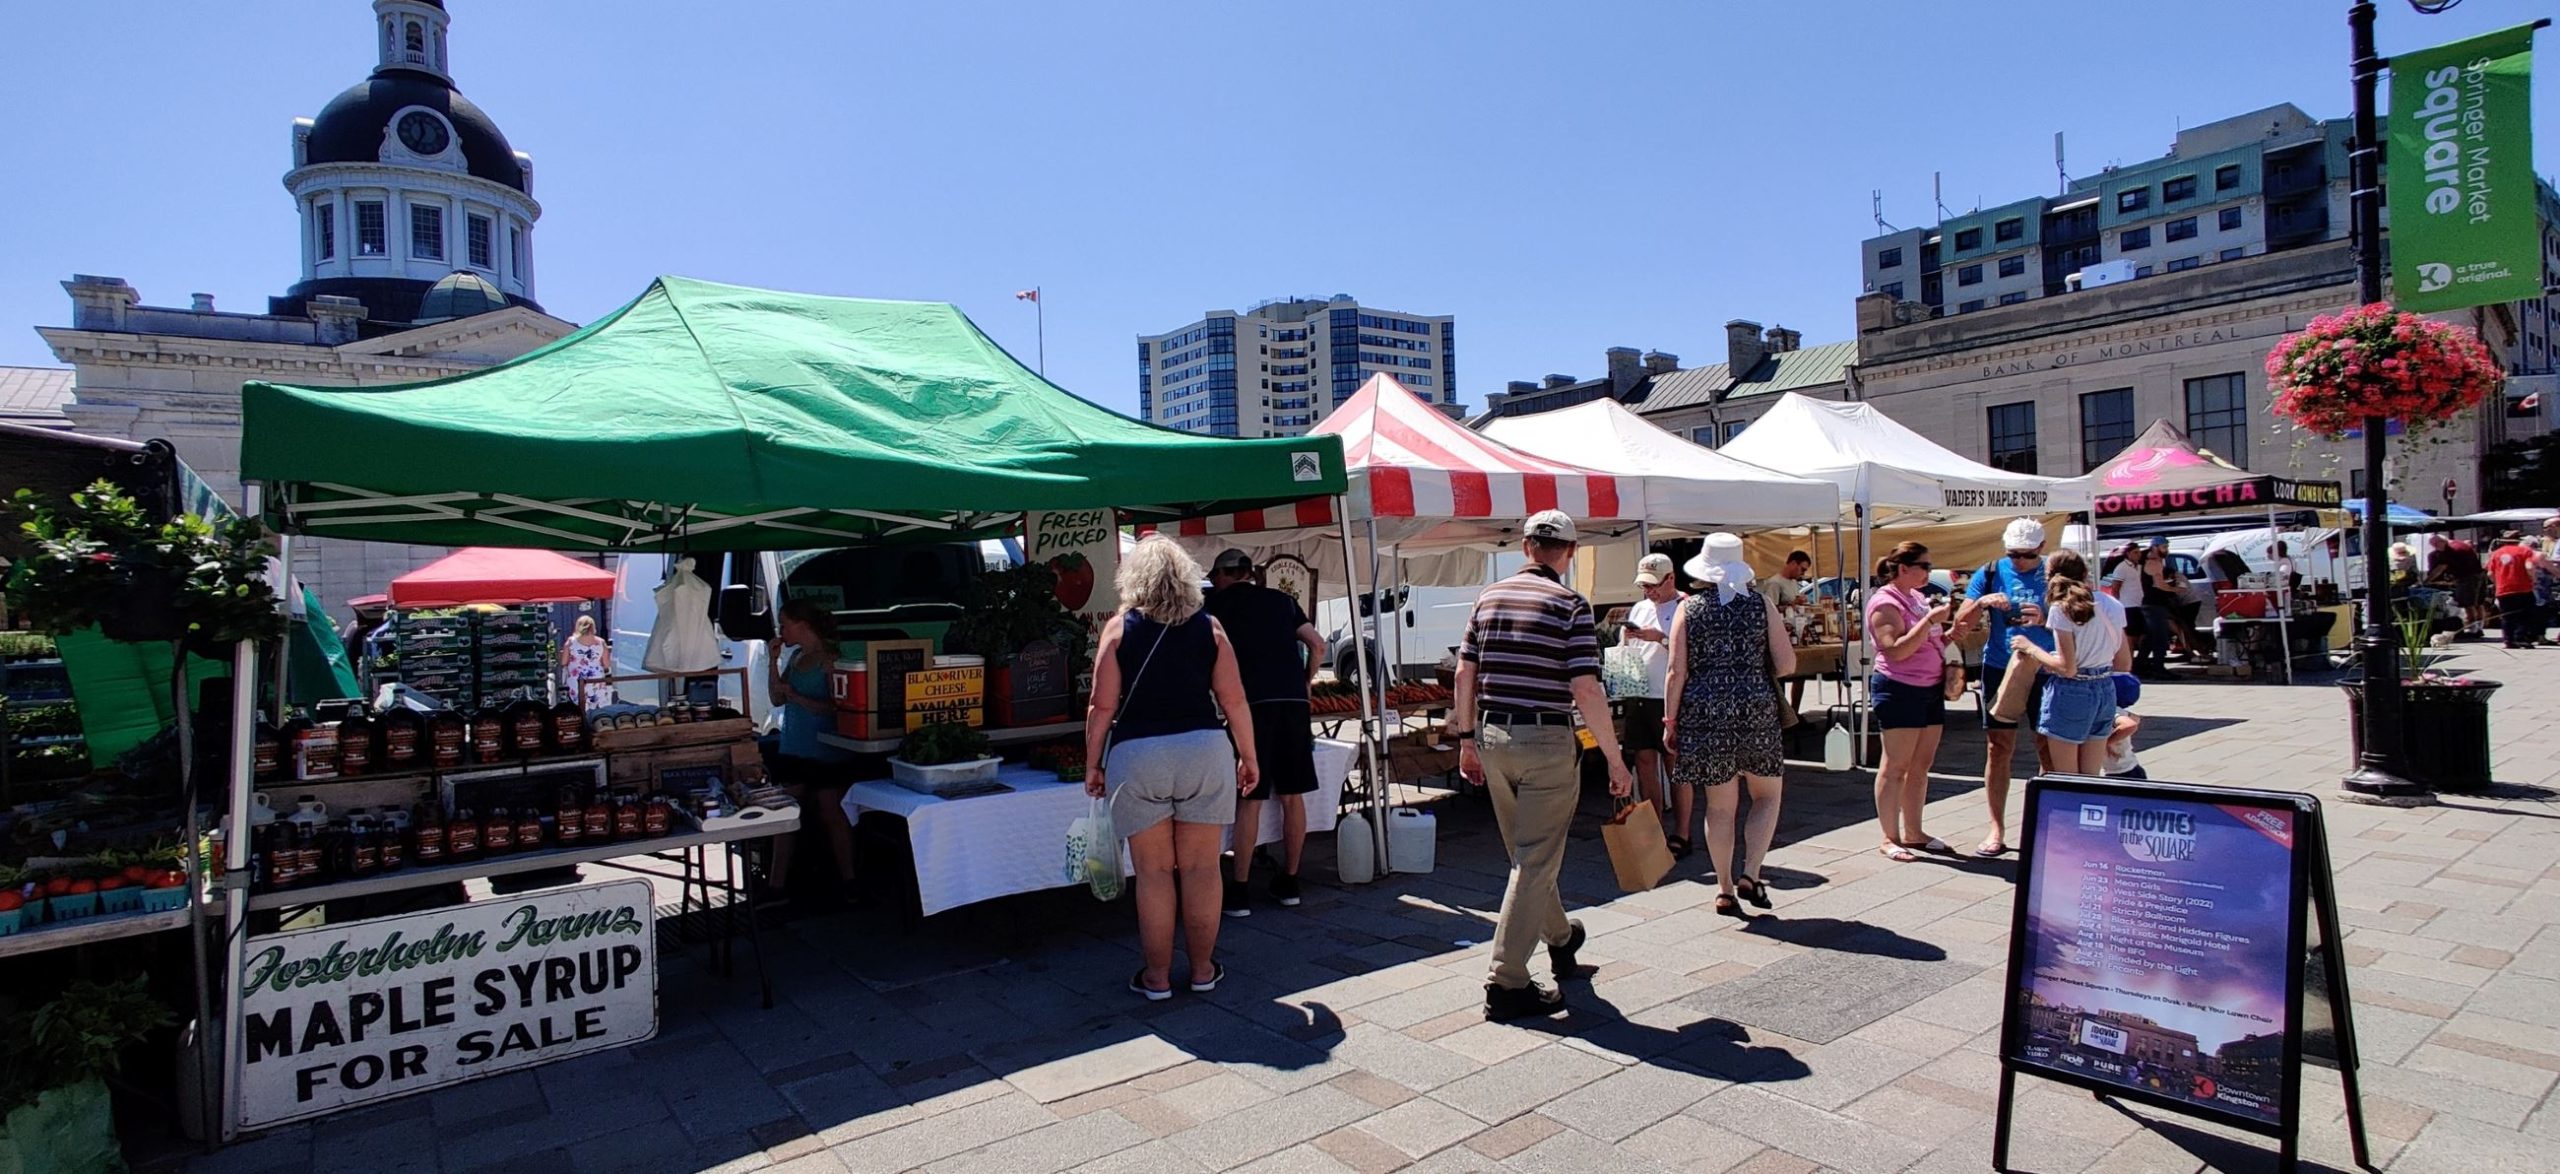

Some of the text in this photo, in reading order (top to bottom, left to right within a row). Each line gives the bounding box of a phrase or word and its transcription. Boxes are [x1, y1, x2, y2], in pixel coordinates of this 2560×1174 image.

[2413, 65, 2460, 214] square
[2461, 57, 2493, 225] Springer Market
[2456, 261, 2497, 273] a true
[2457, 268, 2512, 285] original.
[1983, 327, 2241, 378] BANK OF MONTREAL
[1945, 489, 2048, 507] VADER'S MAPLE SYRUP
[1039, 511, 1103, 532] FRESH
[1036, 528, 1107, 555] PICKED
[907, 668, 983, 685] BLACK RIVER
[924, 682, 967, 697] CHEESE
[911, 697, 980, 711] AVAILABLE
[922, 709, 970, 725] HERE
[2084, 808, 2104, 821] TD
[2120, 808, 2196, 836] MOVIES
[2257, 810, 2286, 830] FREE
[2119, 829, 2195, 862] in the SQUARE
[2083, 861, 2098, 869] Jun
[2115, 864, 2166, 877] Rocketman
[2082, 874, 2096, 882] Jun
[2097, 876, 2108, 884] 23
[2114, 879, 2139, 889] Mean
[2140, 881, 2161, 891] Girls
[2112, 897, 2136, 907] Pride
[2137, 900, 2143, 908] &
[2144, 902, 2189, 915] Prejudice
[2113, 888, 2136, 897] West
[2137, 890, 2158, 900] Side
[2158, 892, 2184, 905] Story
[2185, 897, 2214, 909] (2022)
[2112, 906, 2143, 918] Strictly
[2144, 912, 2186, 924] Ballroom
[2110, 924, 2131, 935] Best
[2131, 927, 2160, 940] Exotic
[2161, 932, 2203, 947] Marigold
[2203, 939, 2231, 951] Hotel
[2111, 915, 2136, 926] Black
[2137, 918, 2157, 929] Soul
[2157, 922, 2177, 933] and
[2178, 925, 2214, 939] Hidden
[2215, 931, 2250, 945] Figures
[243, 904, 643, 998] Fosterholm Farms
[2109, 934, 2134, 946] Night
[2135, 938, 2145, 947] at
[2146, 939, 2162, 950] the
[2164, 943, 2205, 957] Museum
[2109, 943, 2126, 953] The
[2127, 946, 2146, 957] BFG
[2107, 963, 2145, 977] Encanto
[2108, 953, 2143, 966] Blinded
[2143, 958, 2155, 970] by
[2157, 960, 2173, 971] the
[2174, 964, 2200, 977] Light
[245, 944, 642, 1064] MAPLE SYRUP
[2115, 987, 2152, 1001] Thursdays
[2162, 996, 2182, 1006] Dusk
[2187, 1000, 2207, 1012] Bring
[2208, 1005, 2226, 1016] Your
[2227, 1009, 2250, 1020] Lawn
[2250, 1013, 2274, 1024] Chair
[296, 1006, 608, 1102] FOR SALE
[2093, 1060, 2123, 1072] PURE
[2217, 1083, 2271, 1103] Downtown
